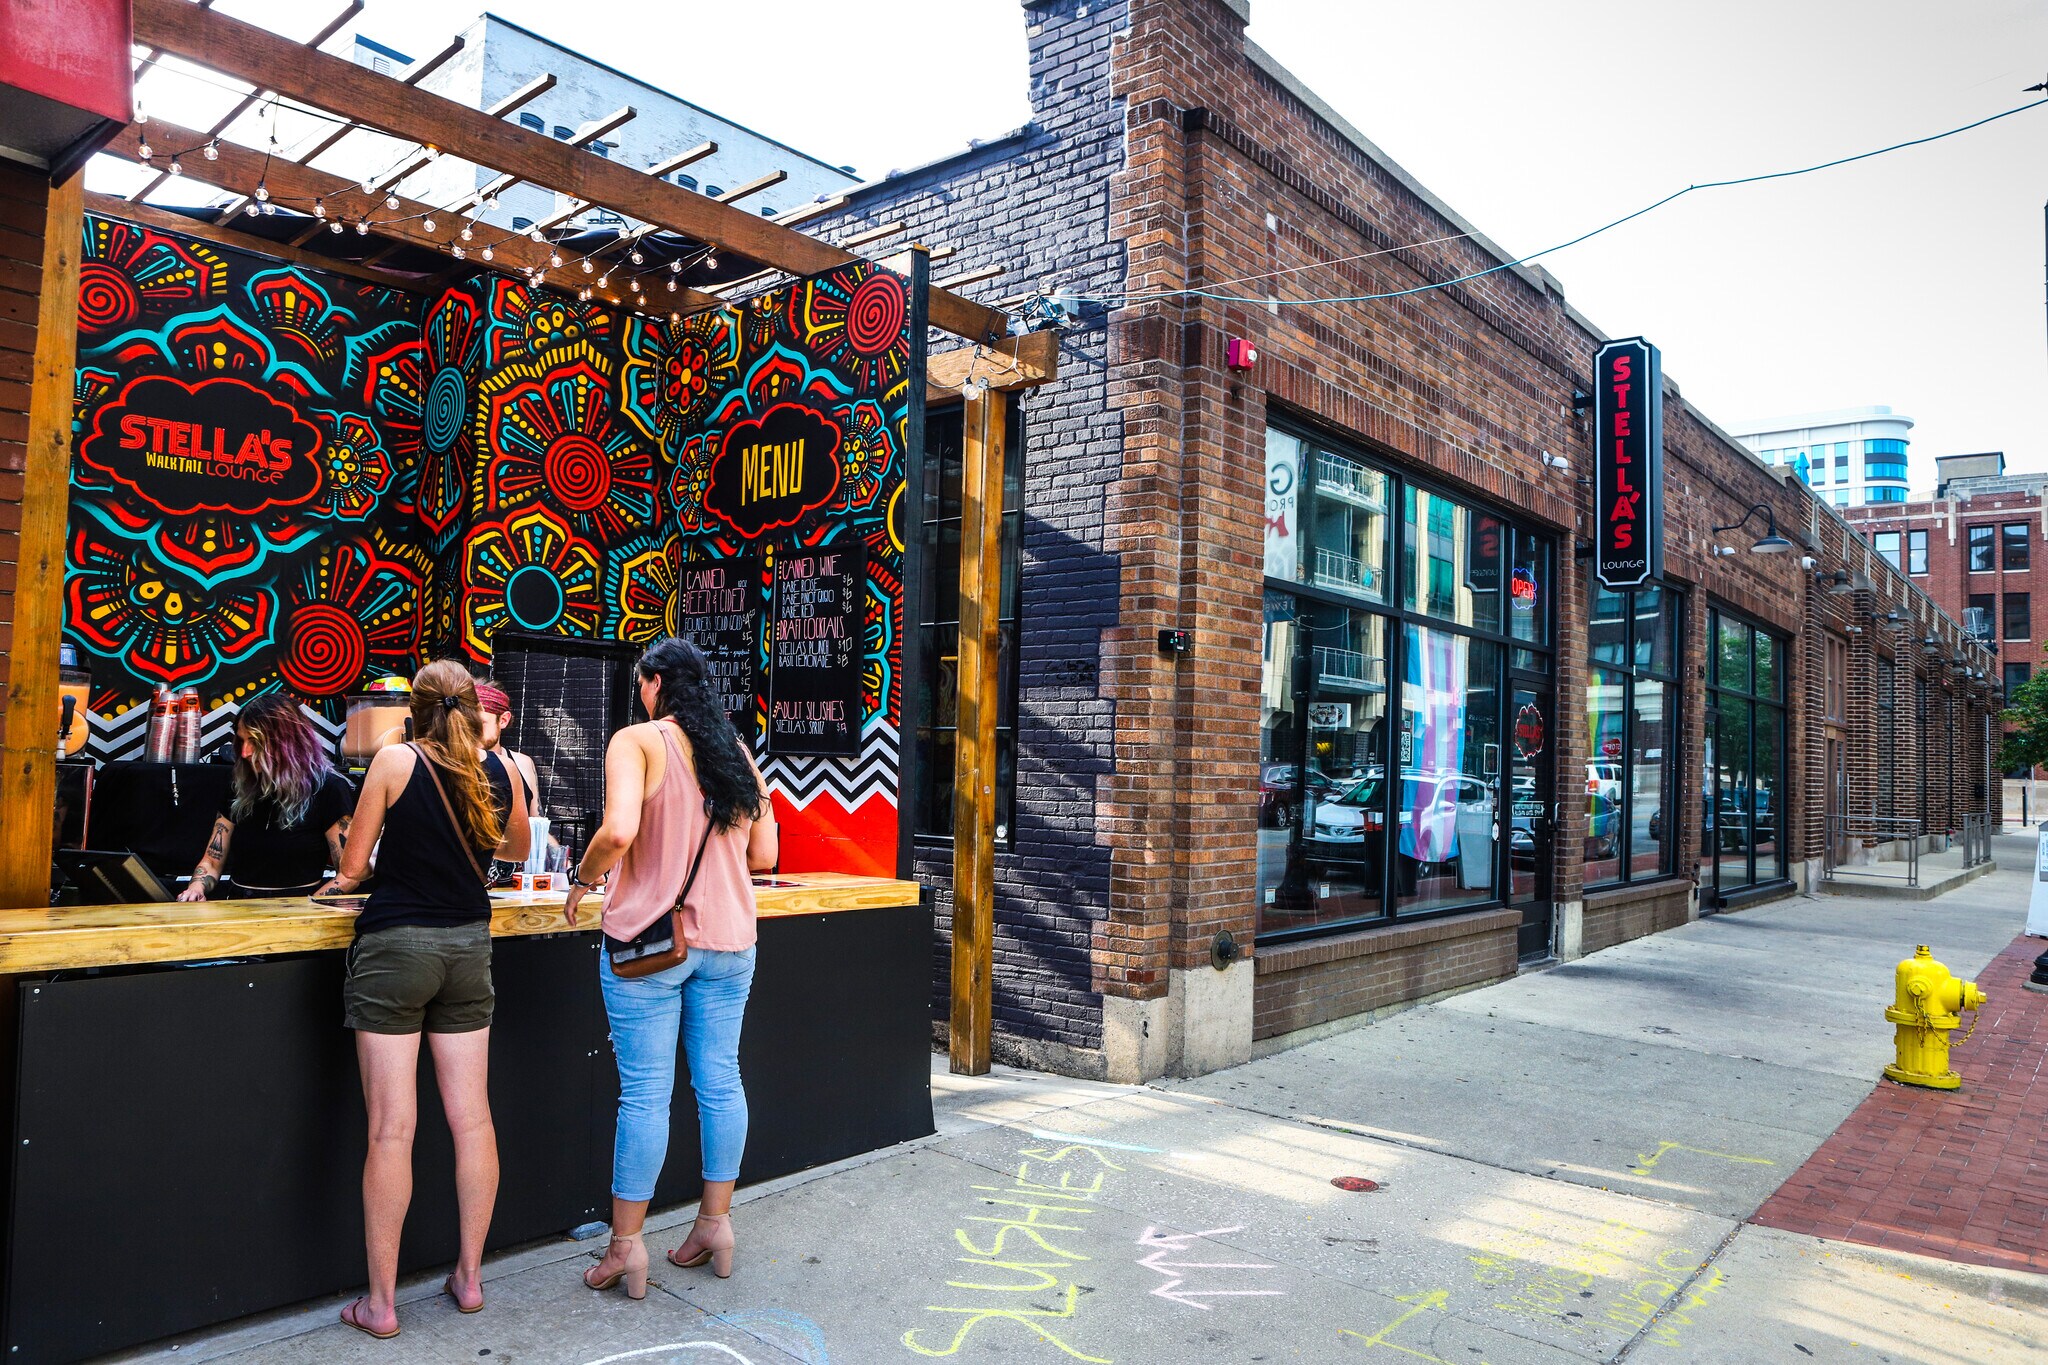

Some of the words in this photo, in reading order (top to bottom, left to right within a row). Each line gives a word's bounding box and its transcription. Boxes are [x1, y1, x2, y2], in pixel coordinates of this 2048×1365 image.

[119, 413, 293, 471] STELLA'S
[1610, 356, 1640, 549] STELLA'S
[741, 438, 805, 507] MENU
[782, 557, 815, 580] CANNED
[819, 554, 841, 577] WINE
[1602, 559, 1645, 571] LOUNGE
[686, 568, 726, 590] CANNED
[685, 590, 711, 615] BEER
[719, 587, 746, 613] CIDER
[742, 630, 754, 646] $5
[779, 618, 802, 641] DRAFT
[803, 615, 845, 640] COCKTAILS
[838, 636, 853, 652] $10
[837, 653, 849, 668] $8
[774, 700, 802, 720] ADULT
[806, 699, 845, 721] SLUSHIES
[899, 1144, 1128, 1365] SLUSHIES
